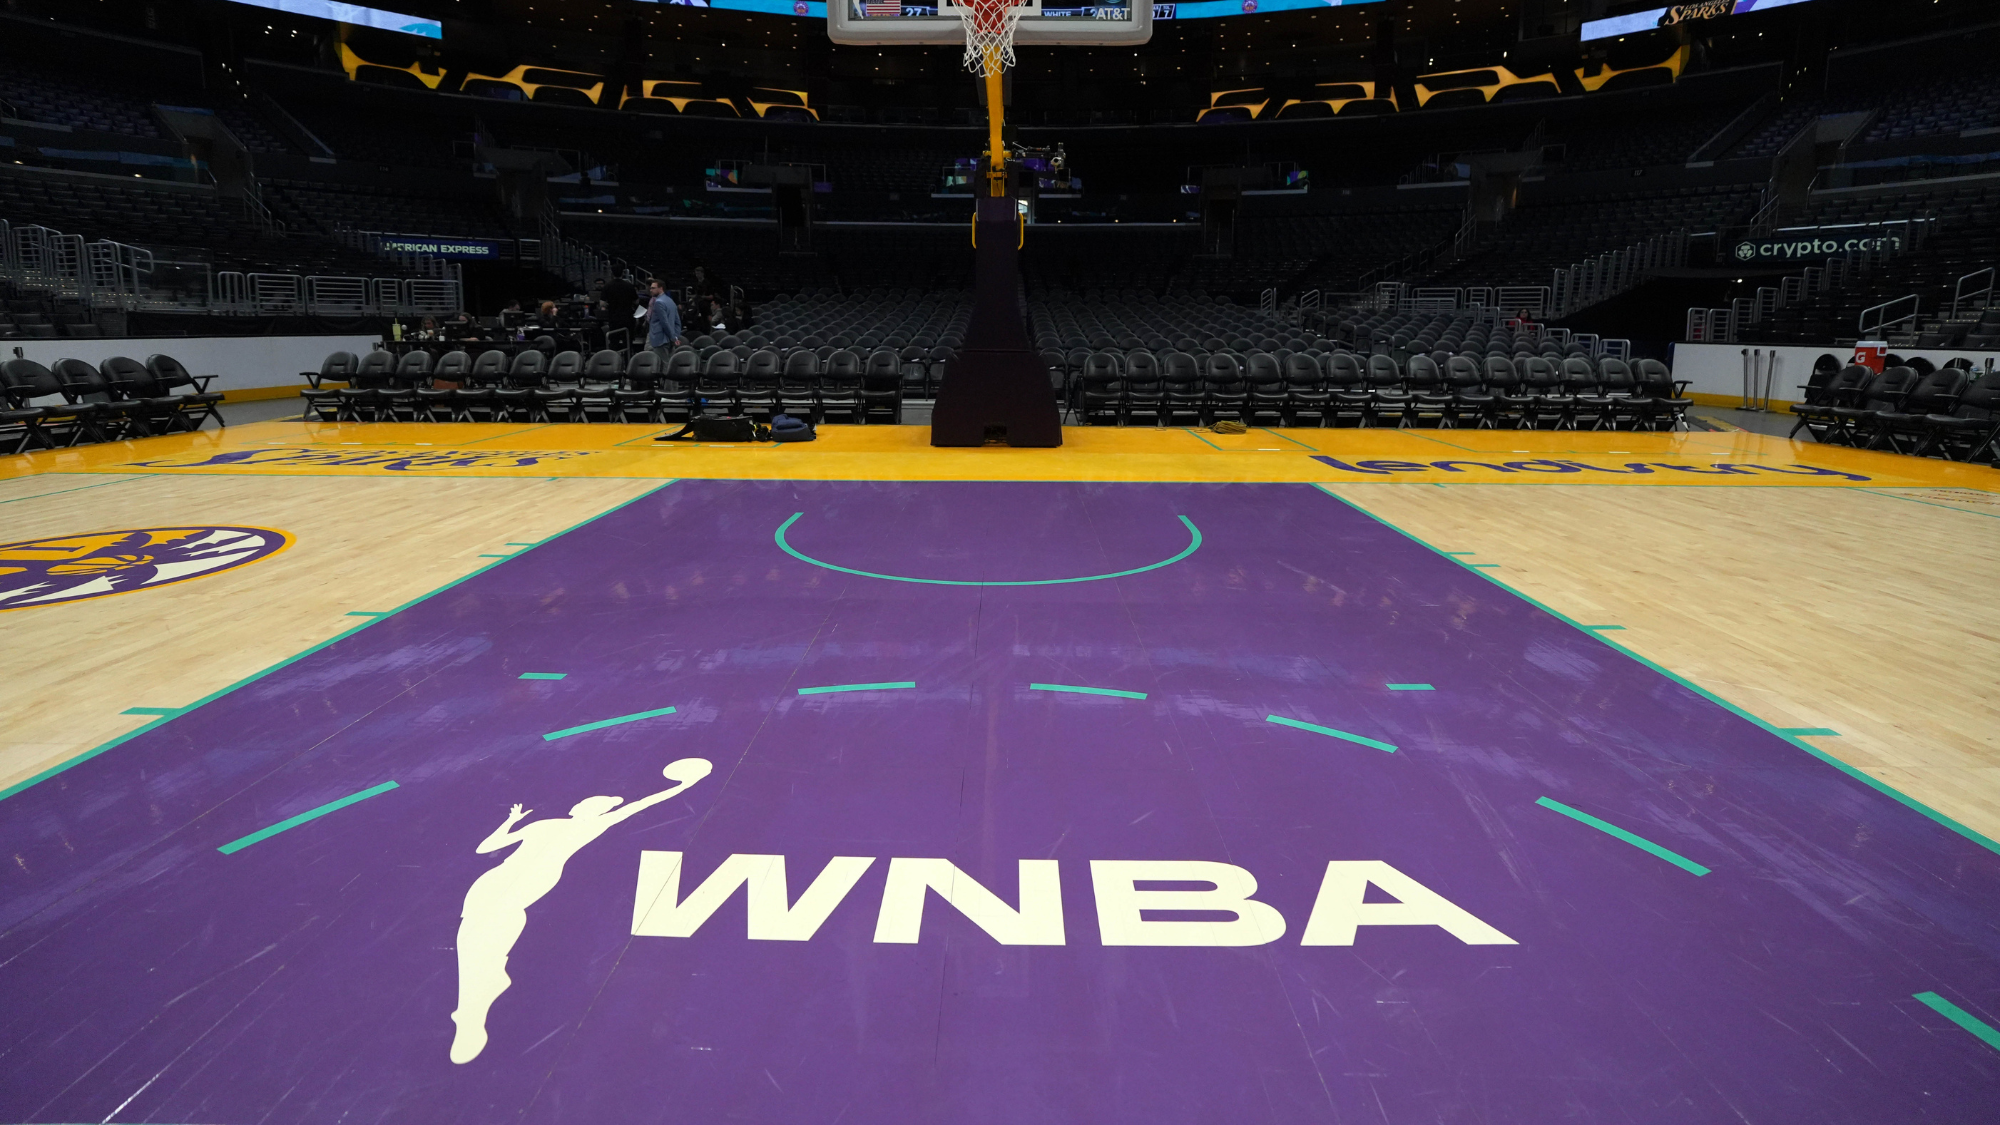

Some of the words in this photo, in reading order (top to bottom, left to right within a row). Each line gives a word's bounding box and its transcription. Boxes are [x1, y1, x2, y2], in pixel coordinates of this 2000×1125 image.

[1096, 8, 1130, 20] AT&T
[1664, 3, 1729, 25] SPARKS
[384, 242, 437, 252] MERICAN
[440, 244, 489, 254] EXPRESS
[1760, 237, 1900, 258] crypto.com
[1856, 352, 1866, 363] G
[630, 850, 1520, 947] WNBA
